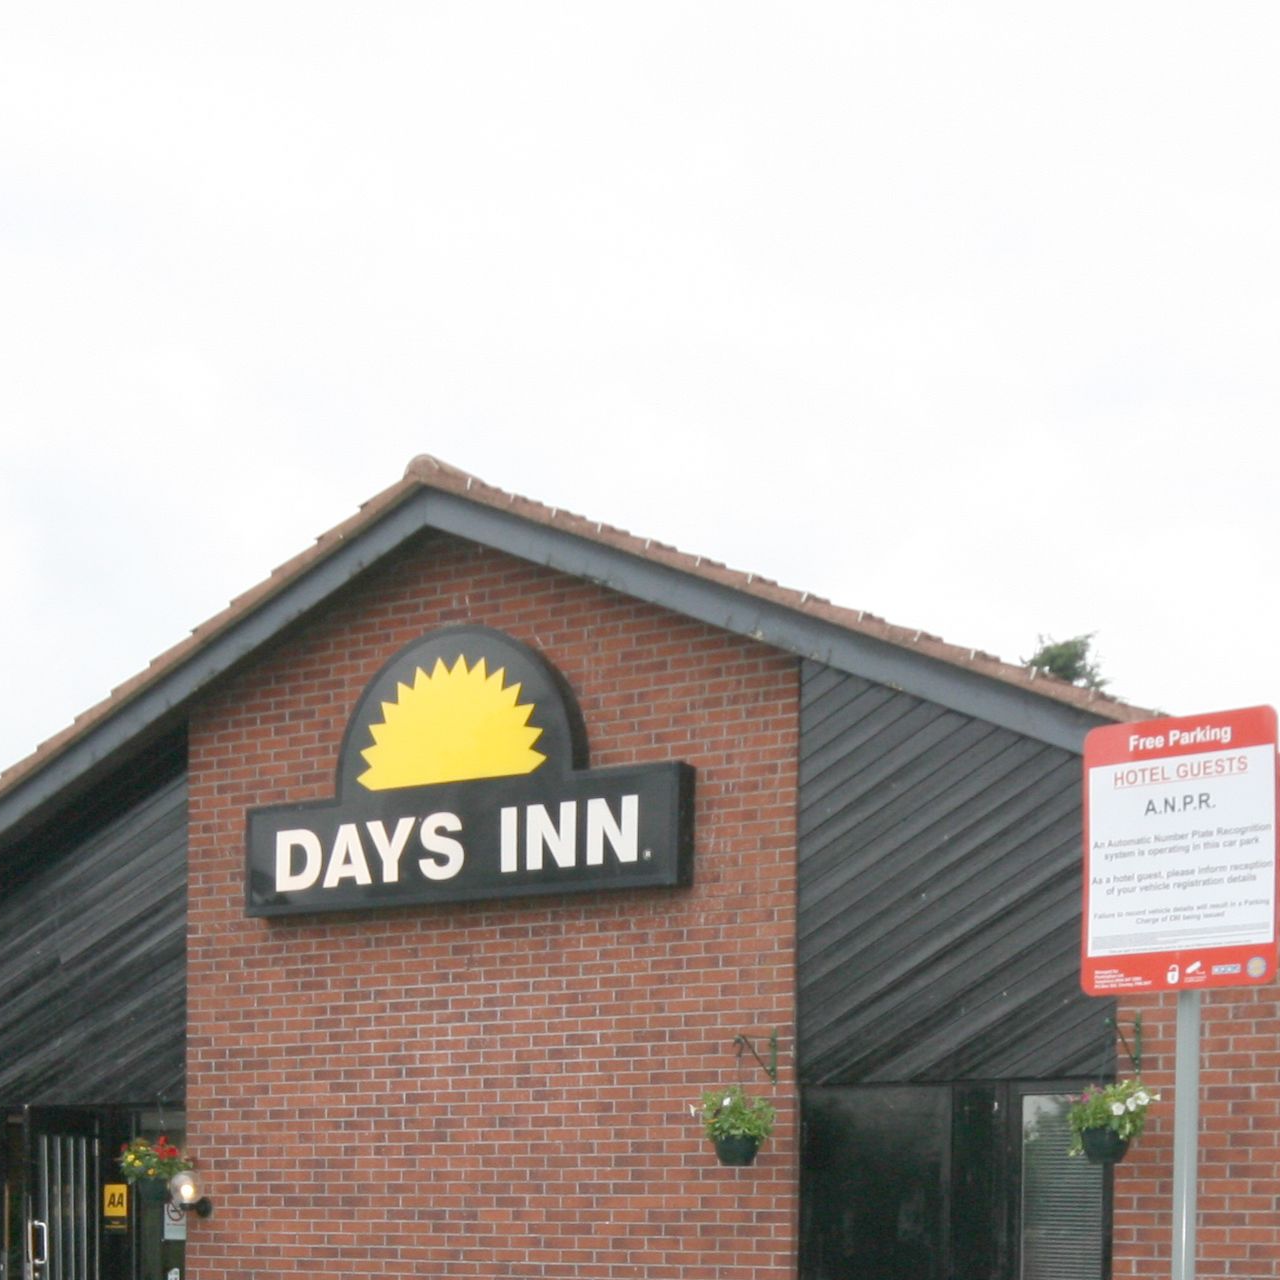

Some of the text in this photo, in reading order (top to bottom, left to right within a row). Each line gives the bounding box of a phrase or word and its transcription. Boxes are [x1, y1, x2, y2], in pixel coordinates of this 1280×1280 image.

[1128, 726, 1232, 751] Free Parking
[1113, 755, 1248, 787] HOTEL GUESTS
[1144, 791, 1217, 816] A.N.P.R.
[275, 794, 639, 892] DAYS INN
[1108, 836, 1151, 848] Automatic
[1154, 832, 1188, 843] Number
[1192, 829, 1213, 839] Plate
[1216, 823, 1272, 836] Recognition
[1104, 850, 1135, 862] system
[1148, 844, 1190, 857] operating
[1223, 840, 1237, 848] car
[1240, 836, 1259, 848] park
[1113, 873, 1135, 883] hotel
[1166, 868, 1195, 879] please
[1198, 864, 1228, 875] inform
[1230, 860, 1273, 873] reception
[1106, 874, 1256, 897] of your vehicle registration details
[107, 1192, 124, 1208] AA
